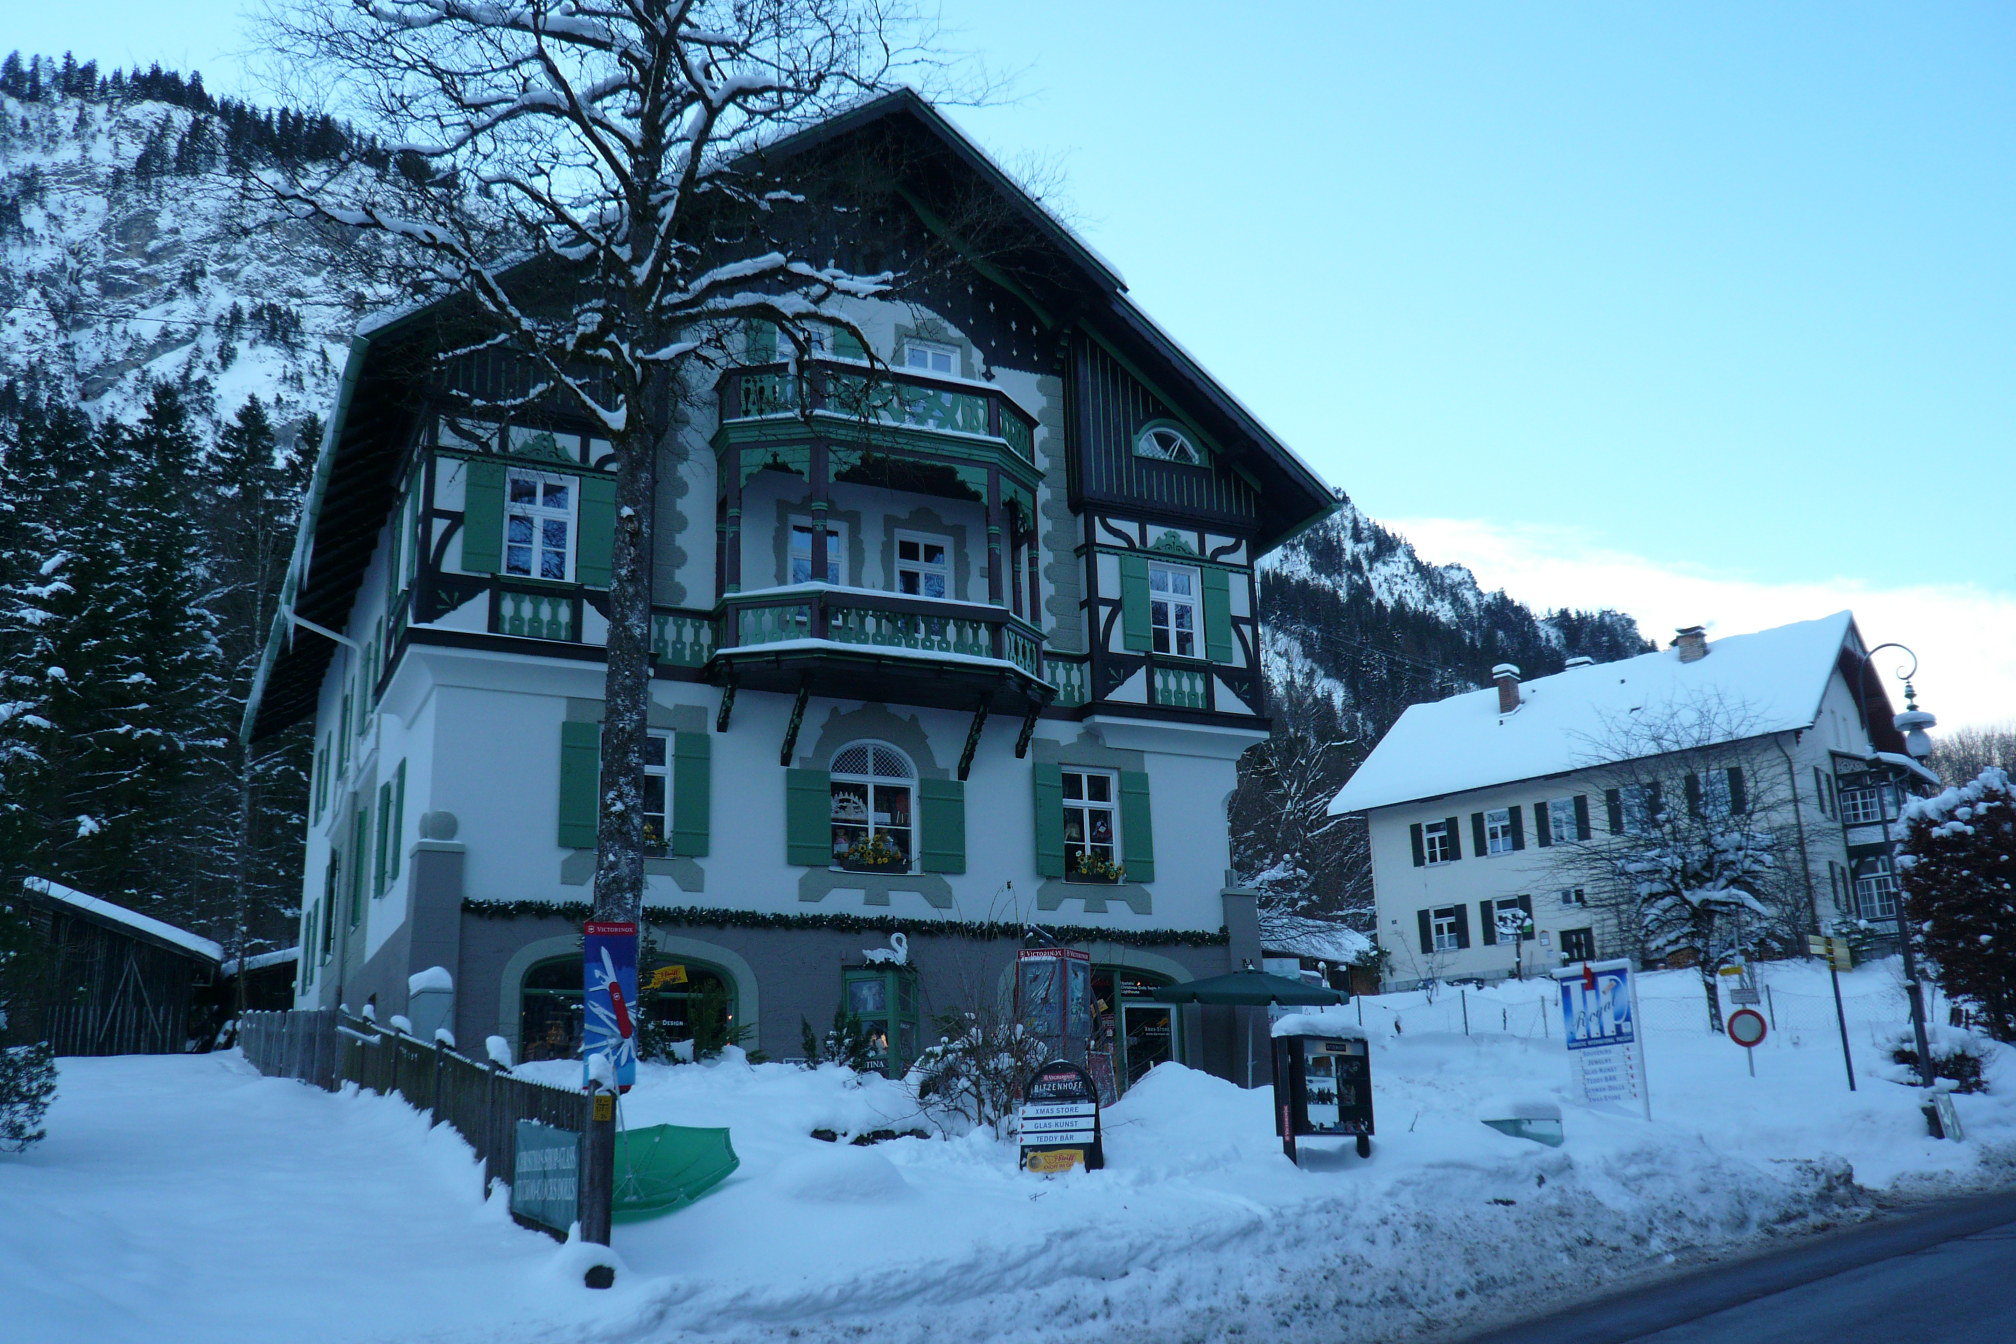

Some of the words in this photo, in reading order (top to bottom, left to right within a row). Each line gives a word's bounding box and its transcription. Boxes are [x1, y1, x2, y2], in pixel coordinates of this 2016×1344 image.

[866, 1060, 884, 1068] TINA
[1034, 1081, 1082, 1093] RITZENHOFF
[1035, 1107, 1055, 1115] XMAS
[1056, 1106, 1079, 1114] STORE
[1034, 1122, 1053, 1130] GLAS
[1059, 1133, 1075, 1141] BÄR
